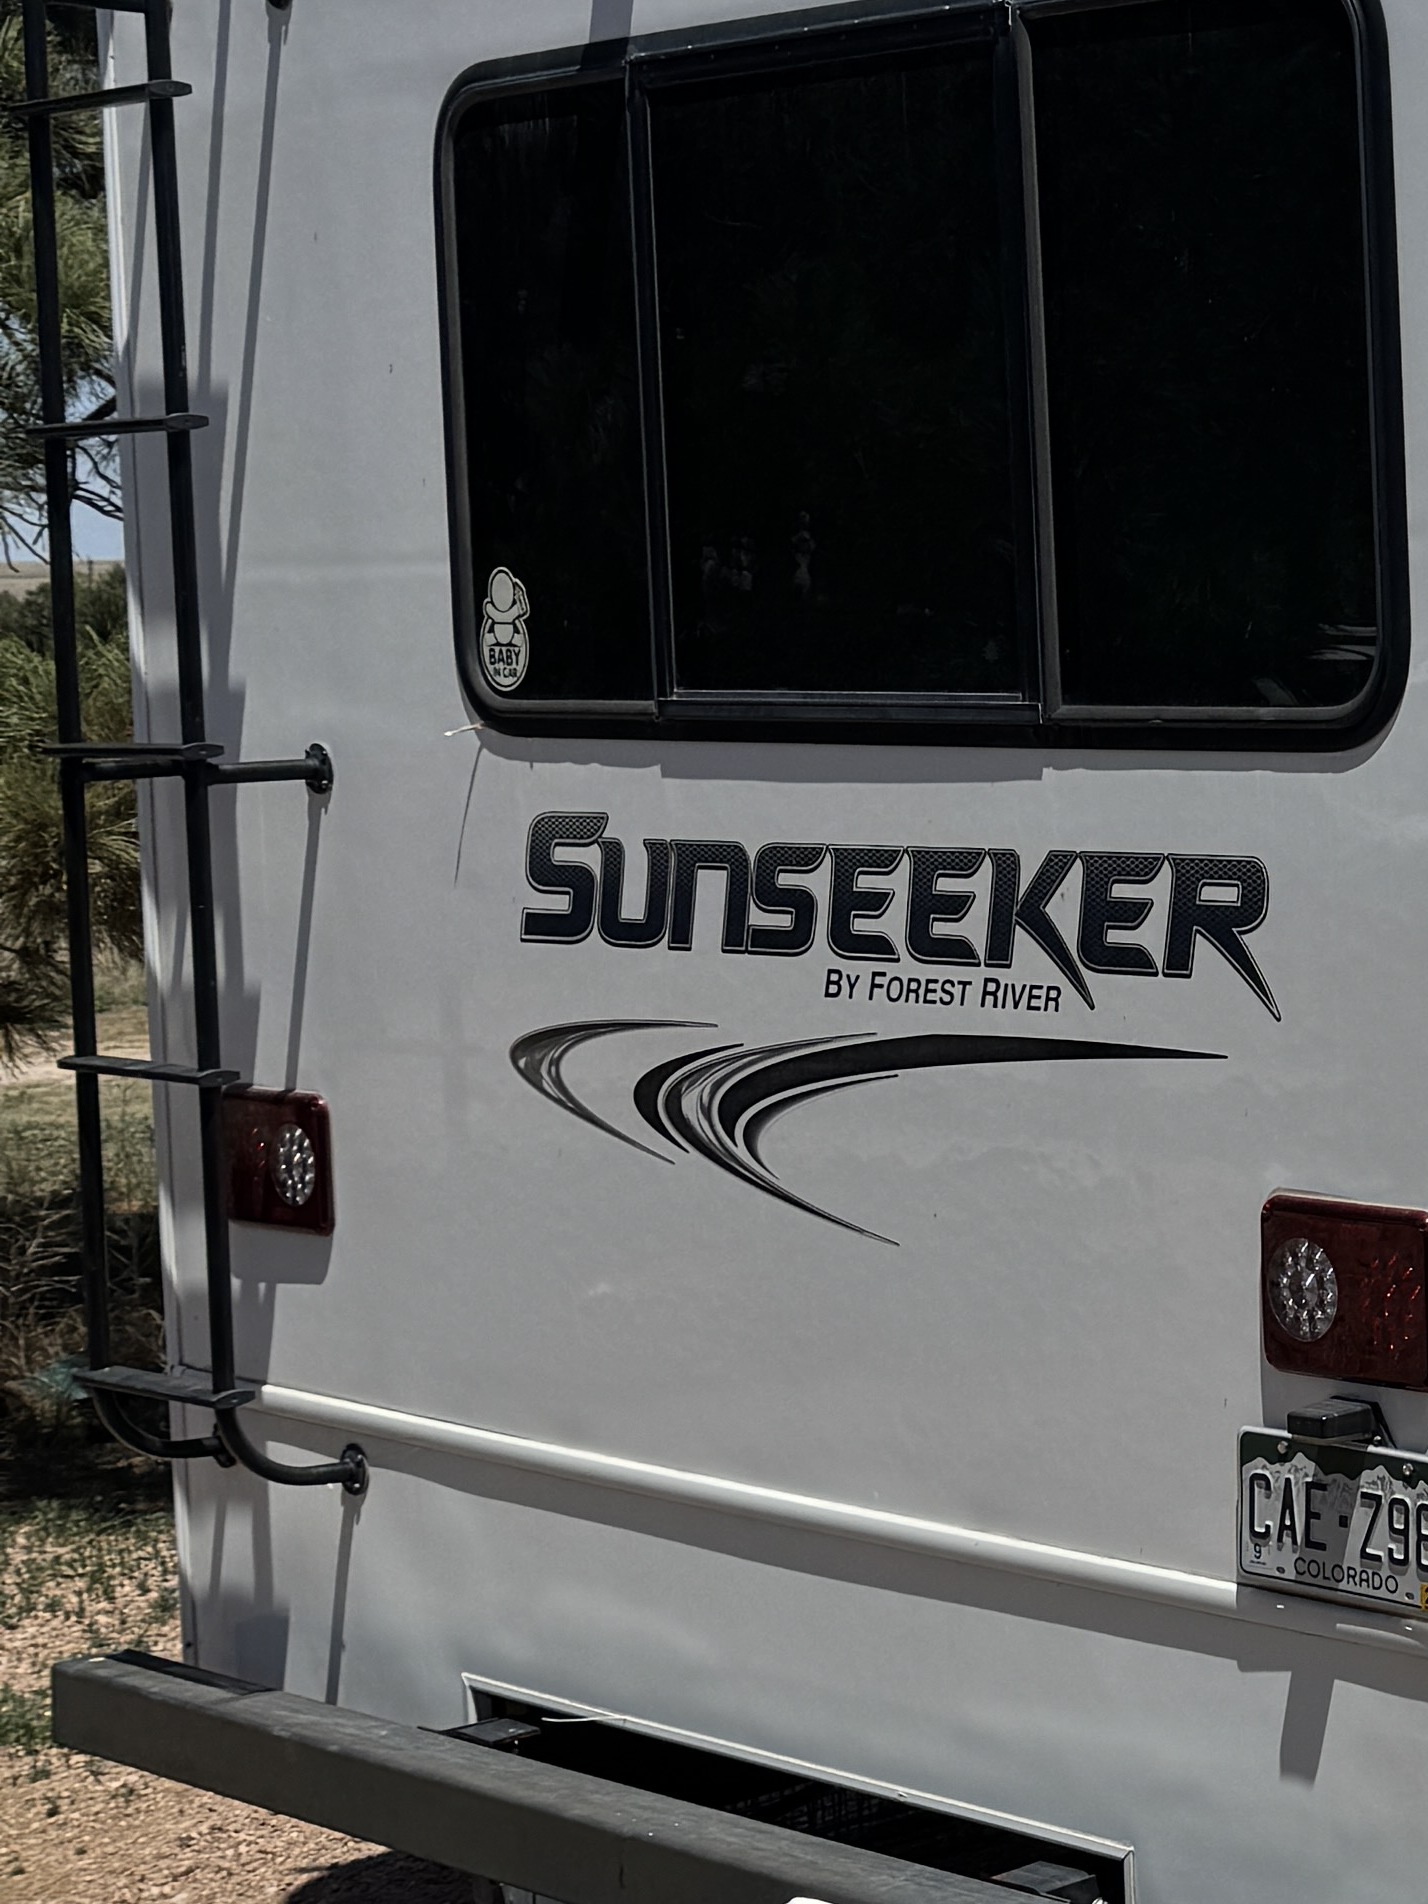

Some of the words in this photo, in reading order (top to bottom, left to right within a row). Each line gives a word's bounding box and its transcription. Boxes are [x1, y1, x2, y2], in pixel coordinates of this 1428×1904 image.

[489, 647, 521, 666] BABY
[868, 971, 973, 1006] FOREST
[980, 977, 1062, 1013] RIVER
[1254, 1543, 1262, 1559] 9
[1294, 1557, 1399, 1593] COLORADO
